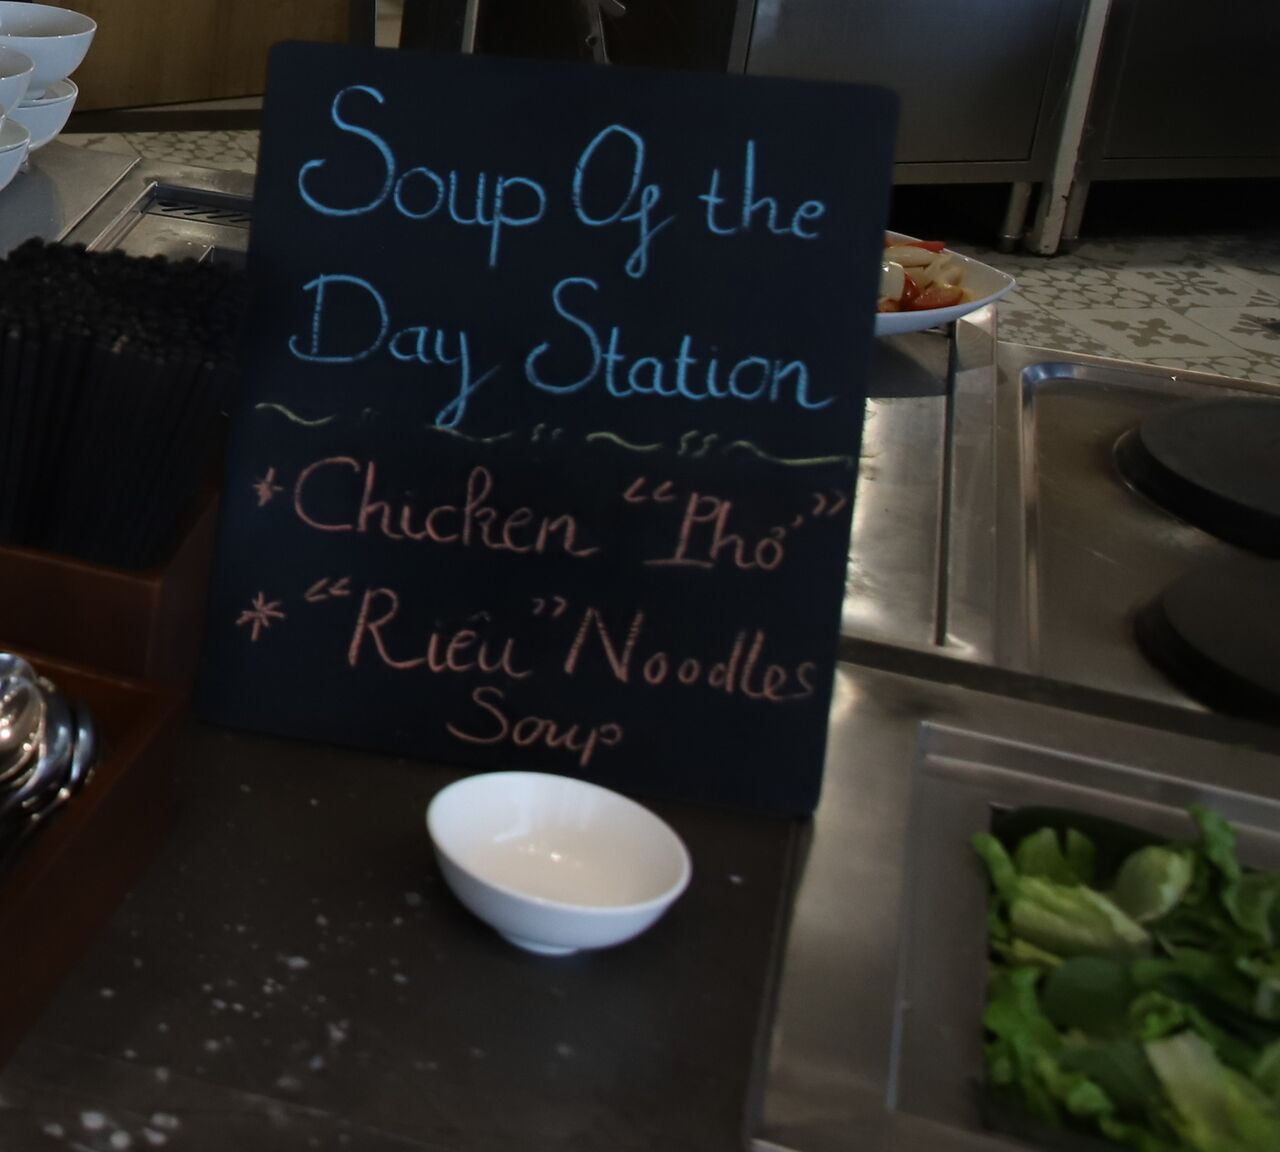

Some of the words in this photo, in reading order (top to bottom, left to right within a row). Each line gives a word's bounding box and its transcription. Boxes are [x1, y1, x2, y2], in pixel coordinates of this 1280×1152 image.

[298, 85, 546, 268] Soup
[572, 123, 677, 279] Of
[699, 138, 828, 238] the
[288, 274, 501, 429] Day
[525, 277, 838, 409] Station
[293, 456, 601, 559] Chicken
[563, 605, 817, 702] Noodles
[445, 686, 624, 766] Soup
